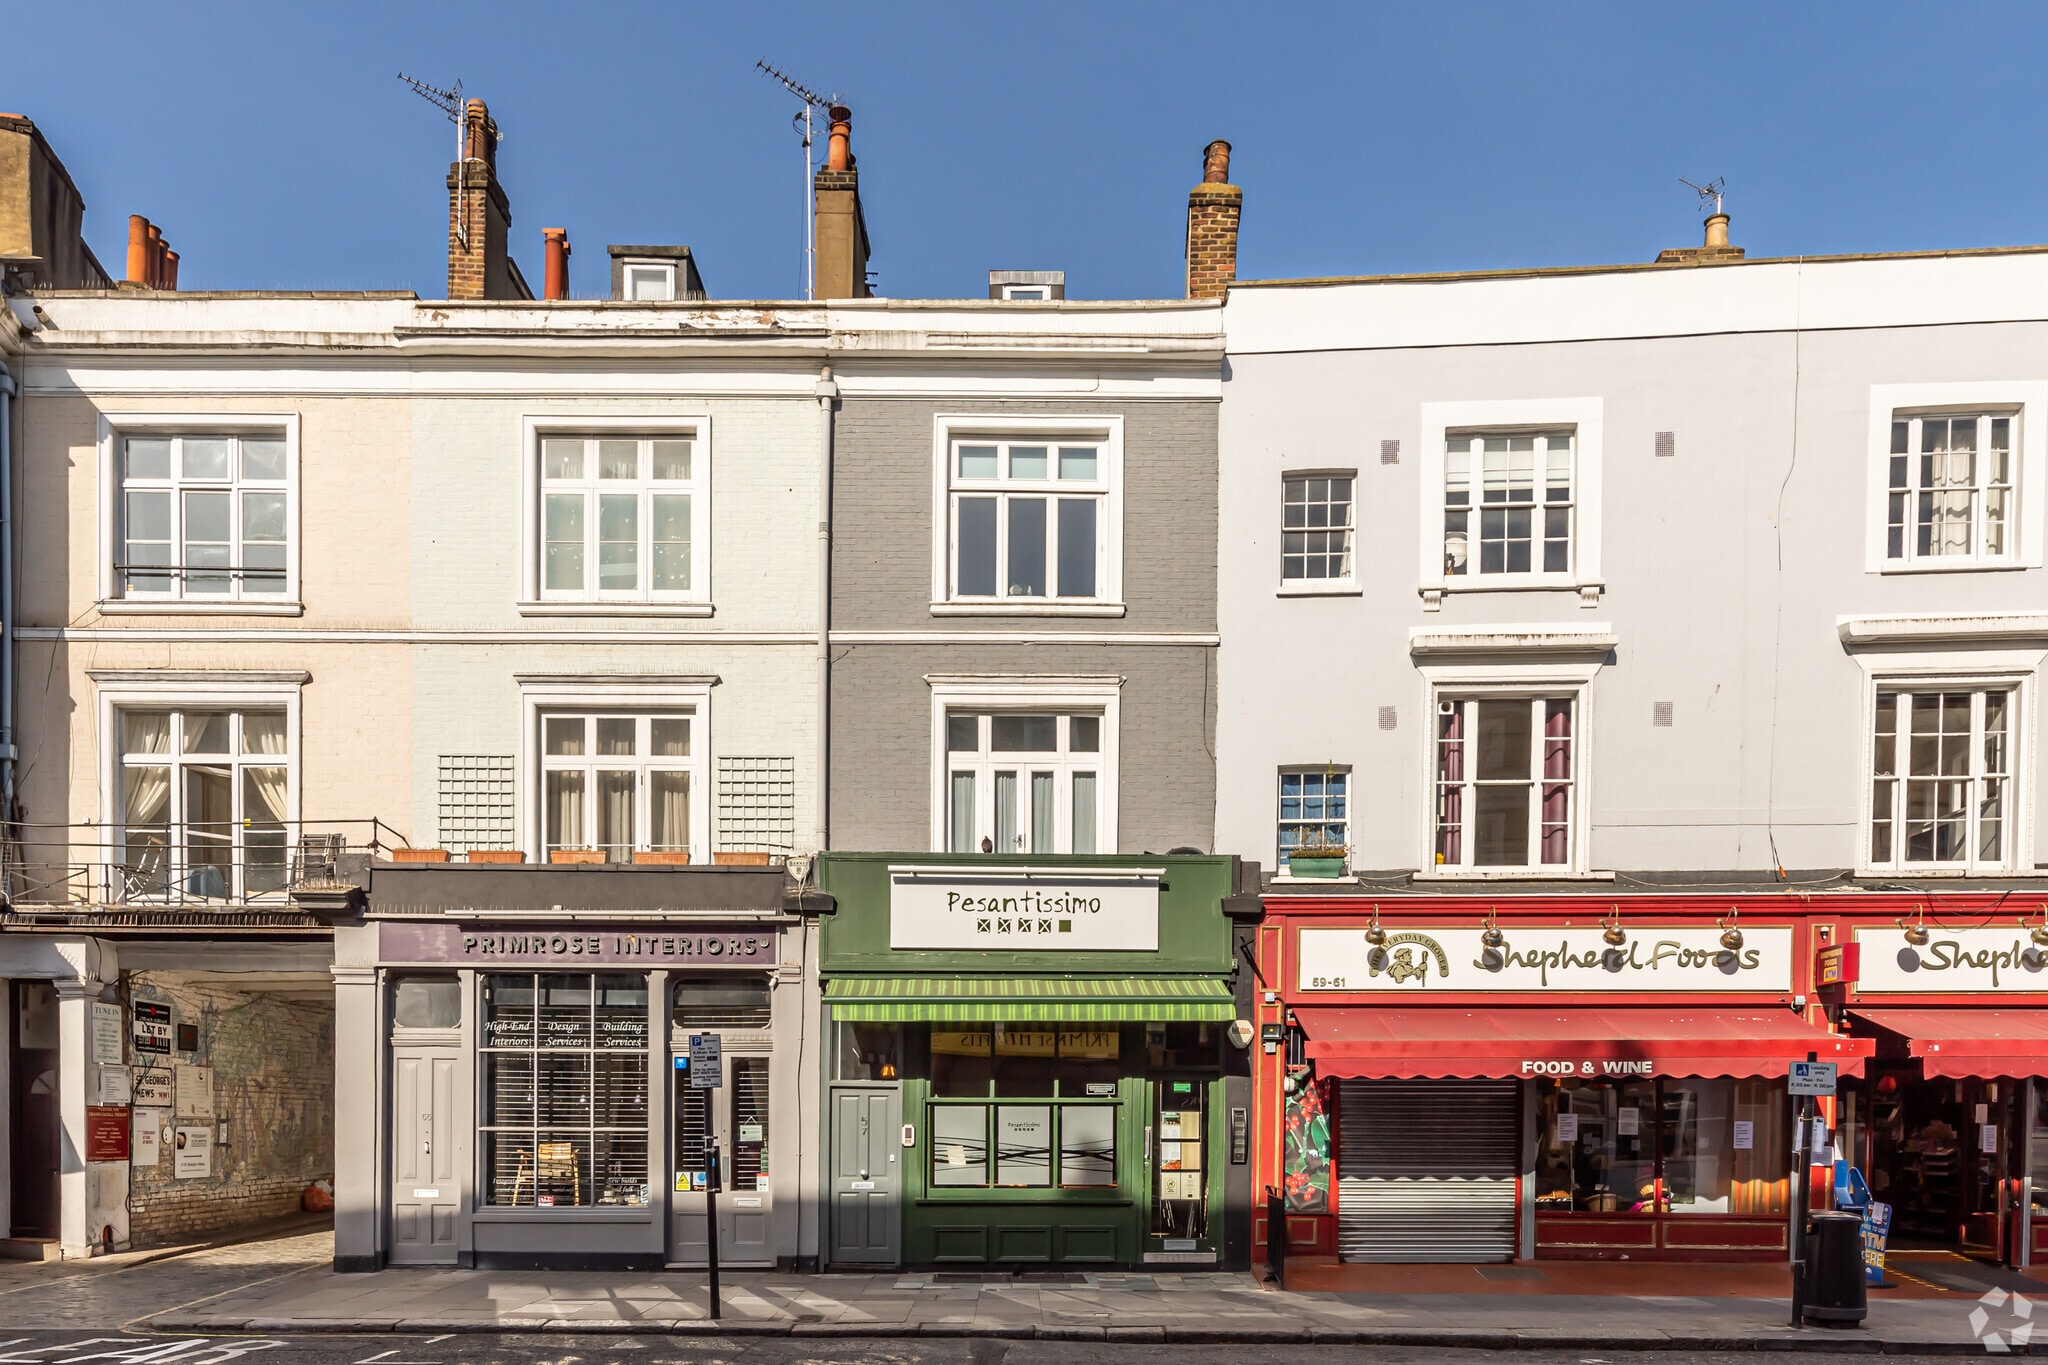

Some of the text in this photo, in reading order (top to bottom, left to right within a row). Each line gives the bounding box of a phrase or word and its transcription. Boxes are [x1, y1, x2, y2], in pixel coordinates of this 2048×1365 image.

[947, 891, 1101, 914] Pesantissimo
[463, 935, 757, 955] PRIMROSE INTERIORS
[1425, 939, 1447, 971] GROCER
[1473, 940, 1760, 986] Shepherd Foods
[1825, 969, 1836, 978] ATM
[1312, 977, 1346, 987] 59-61
[157, 1027, 167, 1036] BY
[484, 1021, 530, 1034] High-End
[548, 1022, 580, 1034] Design
[603, 1021, 643, 1034] Building
[490, 1037, 529, 1046] Interiors
[546, 1037, 582, 1046] Services
[604, 1037, 641, 1047] Services
[1522, 1061, 1653, 1074] FOOD & WINE
[1860, 1231, 1886, 1251] ATM
[1863, 1250, 1883, 1268] ERE
